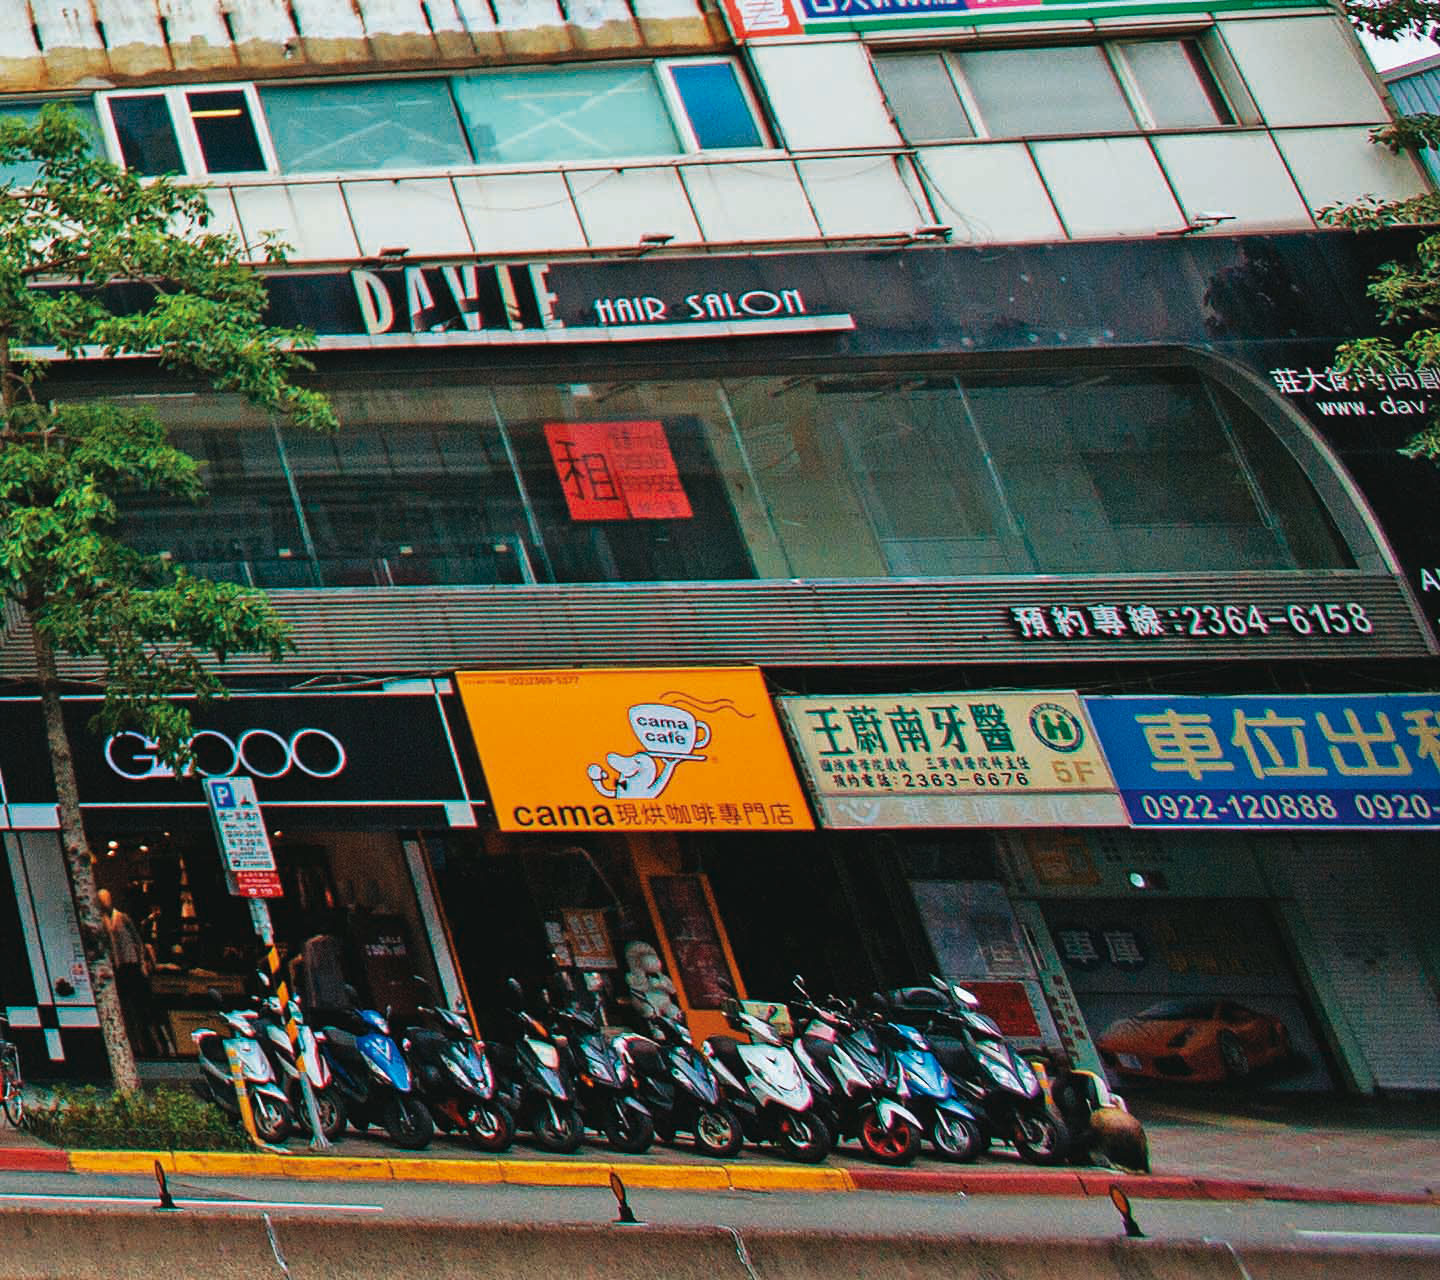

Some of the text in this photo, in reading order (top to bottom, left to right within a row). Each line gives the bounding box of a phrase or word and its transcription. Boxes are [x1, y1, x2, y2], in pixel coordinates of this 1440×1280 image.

[349, 262, 808, 338] DAVIE HAIR SALON
[554, 439, 621, 502] 租
[636, 713, 689, 730] cama
[804, 702, 1017, 756] 王蔚南牙醫
[1049, 759, 1098, 785] 5F
[215, 785, 229, 806] P
[1140, 793, 1338, 821] 0922-120888
[512, 802, 616, 828] cama
[616, 801, 796, 827] 現烘咖啡專門店
